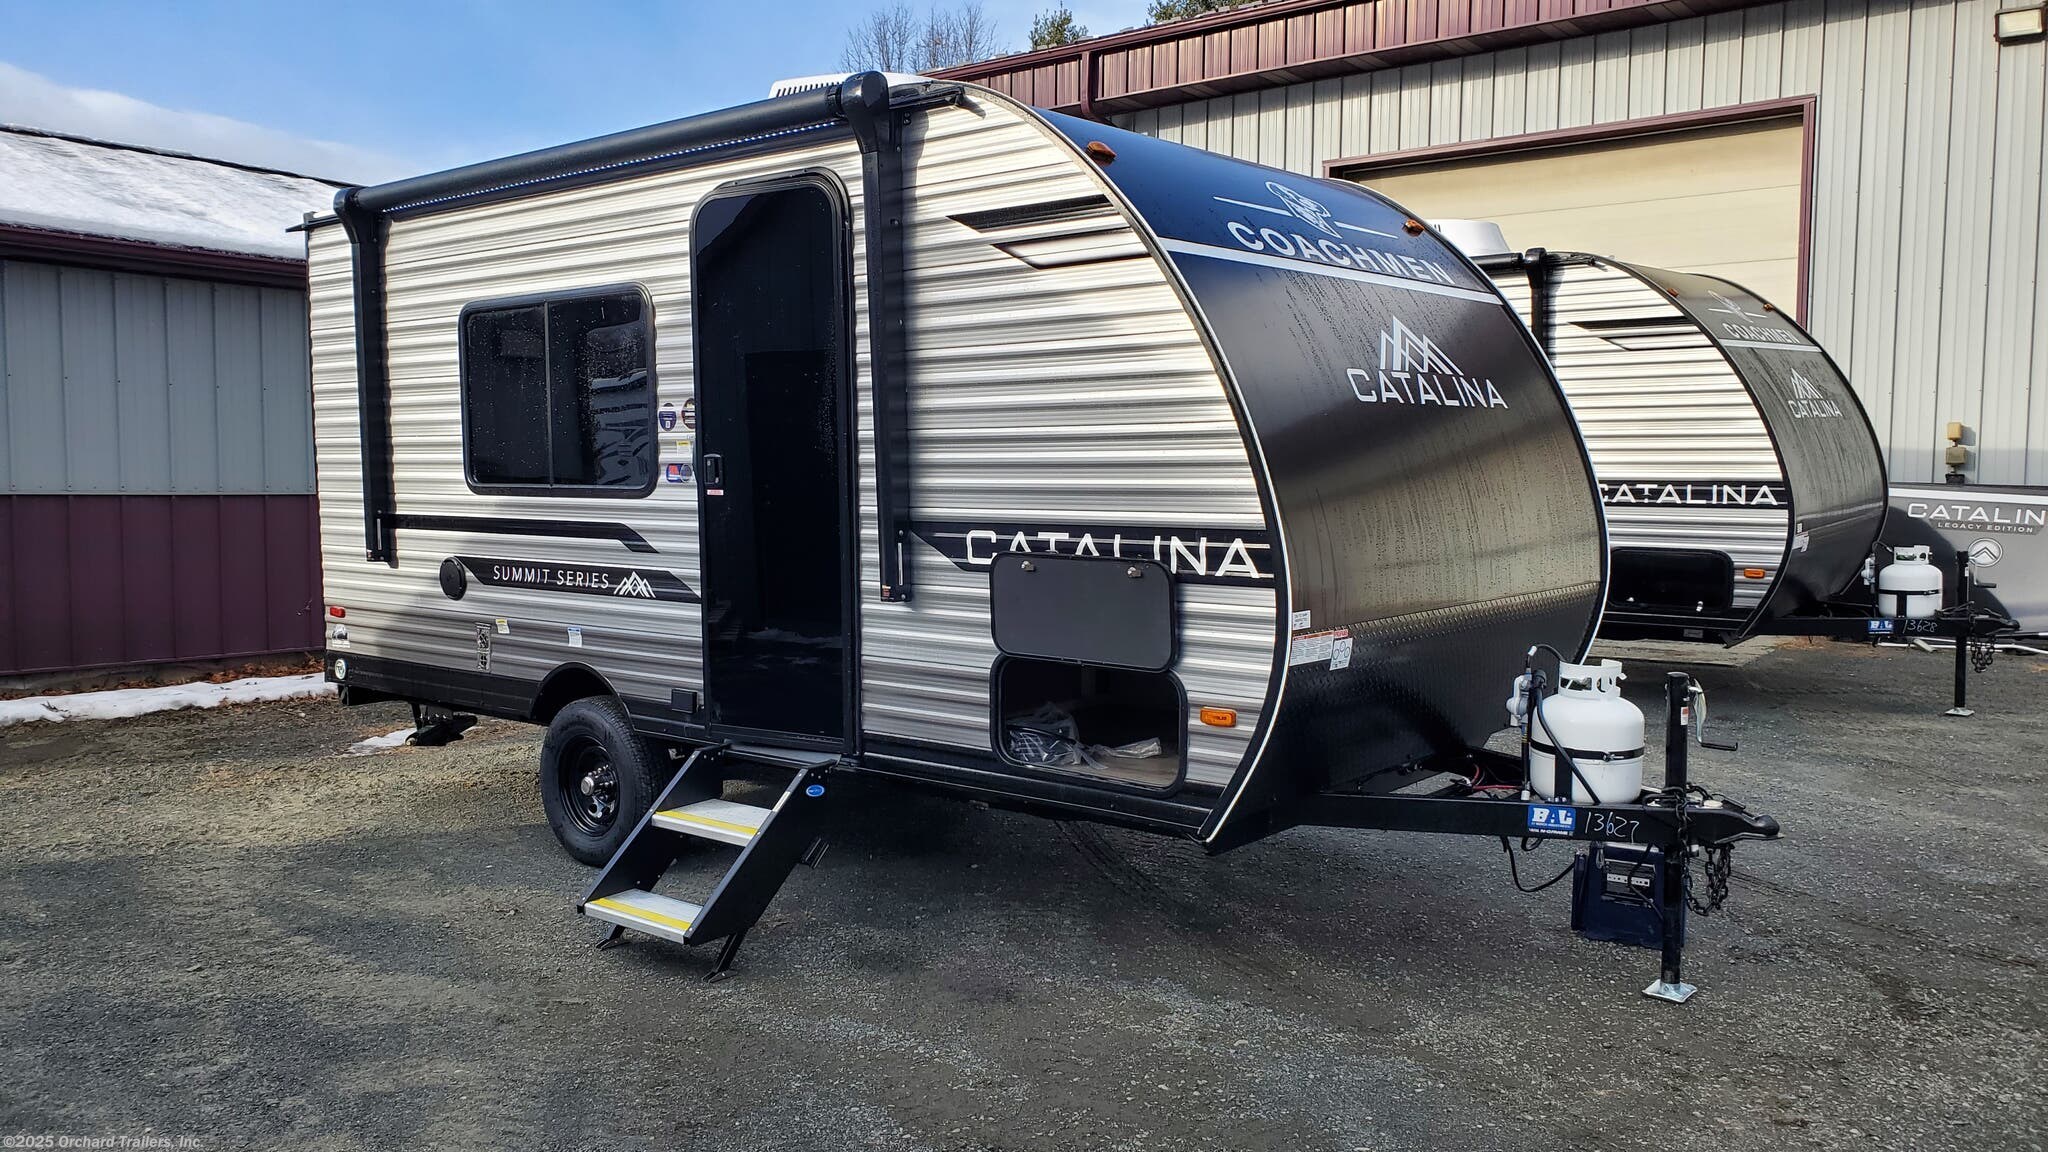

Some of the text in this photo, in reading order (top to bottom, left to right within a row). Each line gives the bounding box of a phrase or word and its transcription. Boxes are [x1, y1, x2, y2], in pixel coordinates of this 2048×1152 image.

[1227, 221, 1455, 285] COACHMEN
[1722, 323, 1801, 344] COACHMEN
[1346, 368, 1509, 409] CATALINA
[1788, 400, 1843, 419] CATALINA
[1907, 503, 2047, 525] CATALIN
[1937, 522, 2033, 533] LEGACY EDITION
[493, 565, 609, 589] SUMMIT SERIES
[1902, 619, 1938, 634] 13628
[1532, 807, 1573, 825] BAL
[1584, 811, 1640, 844] 13627
